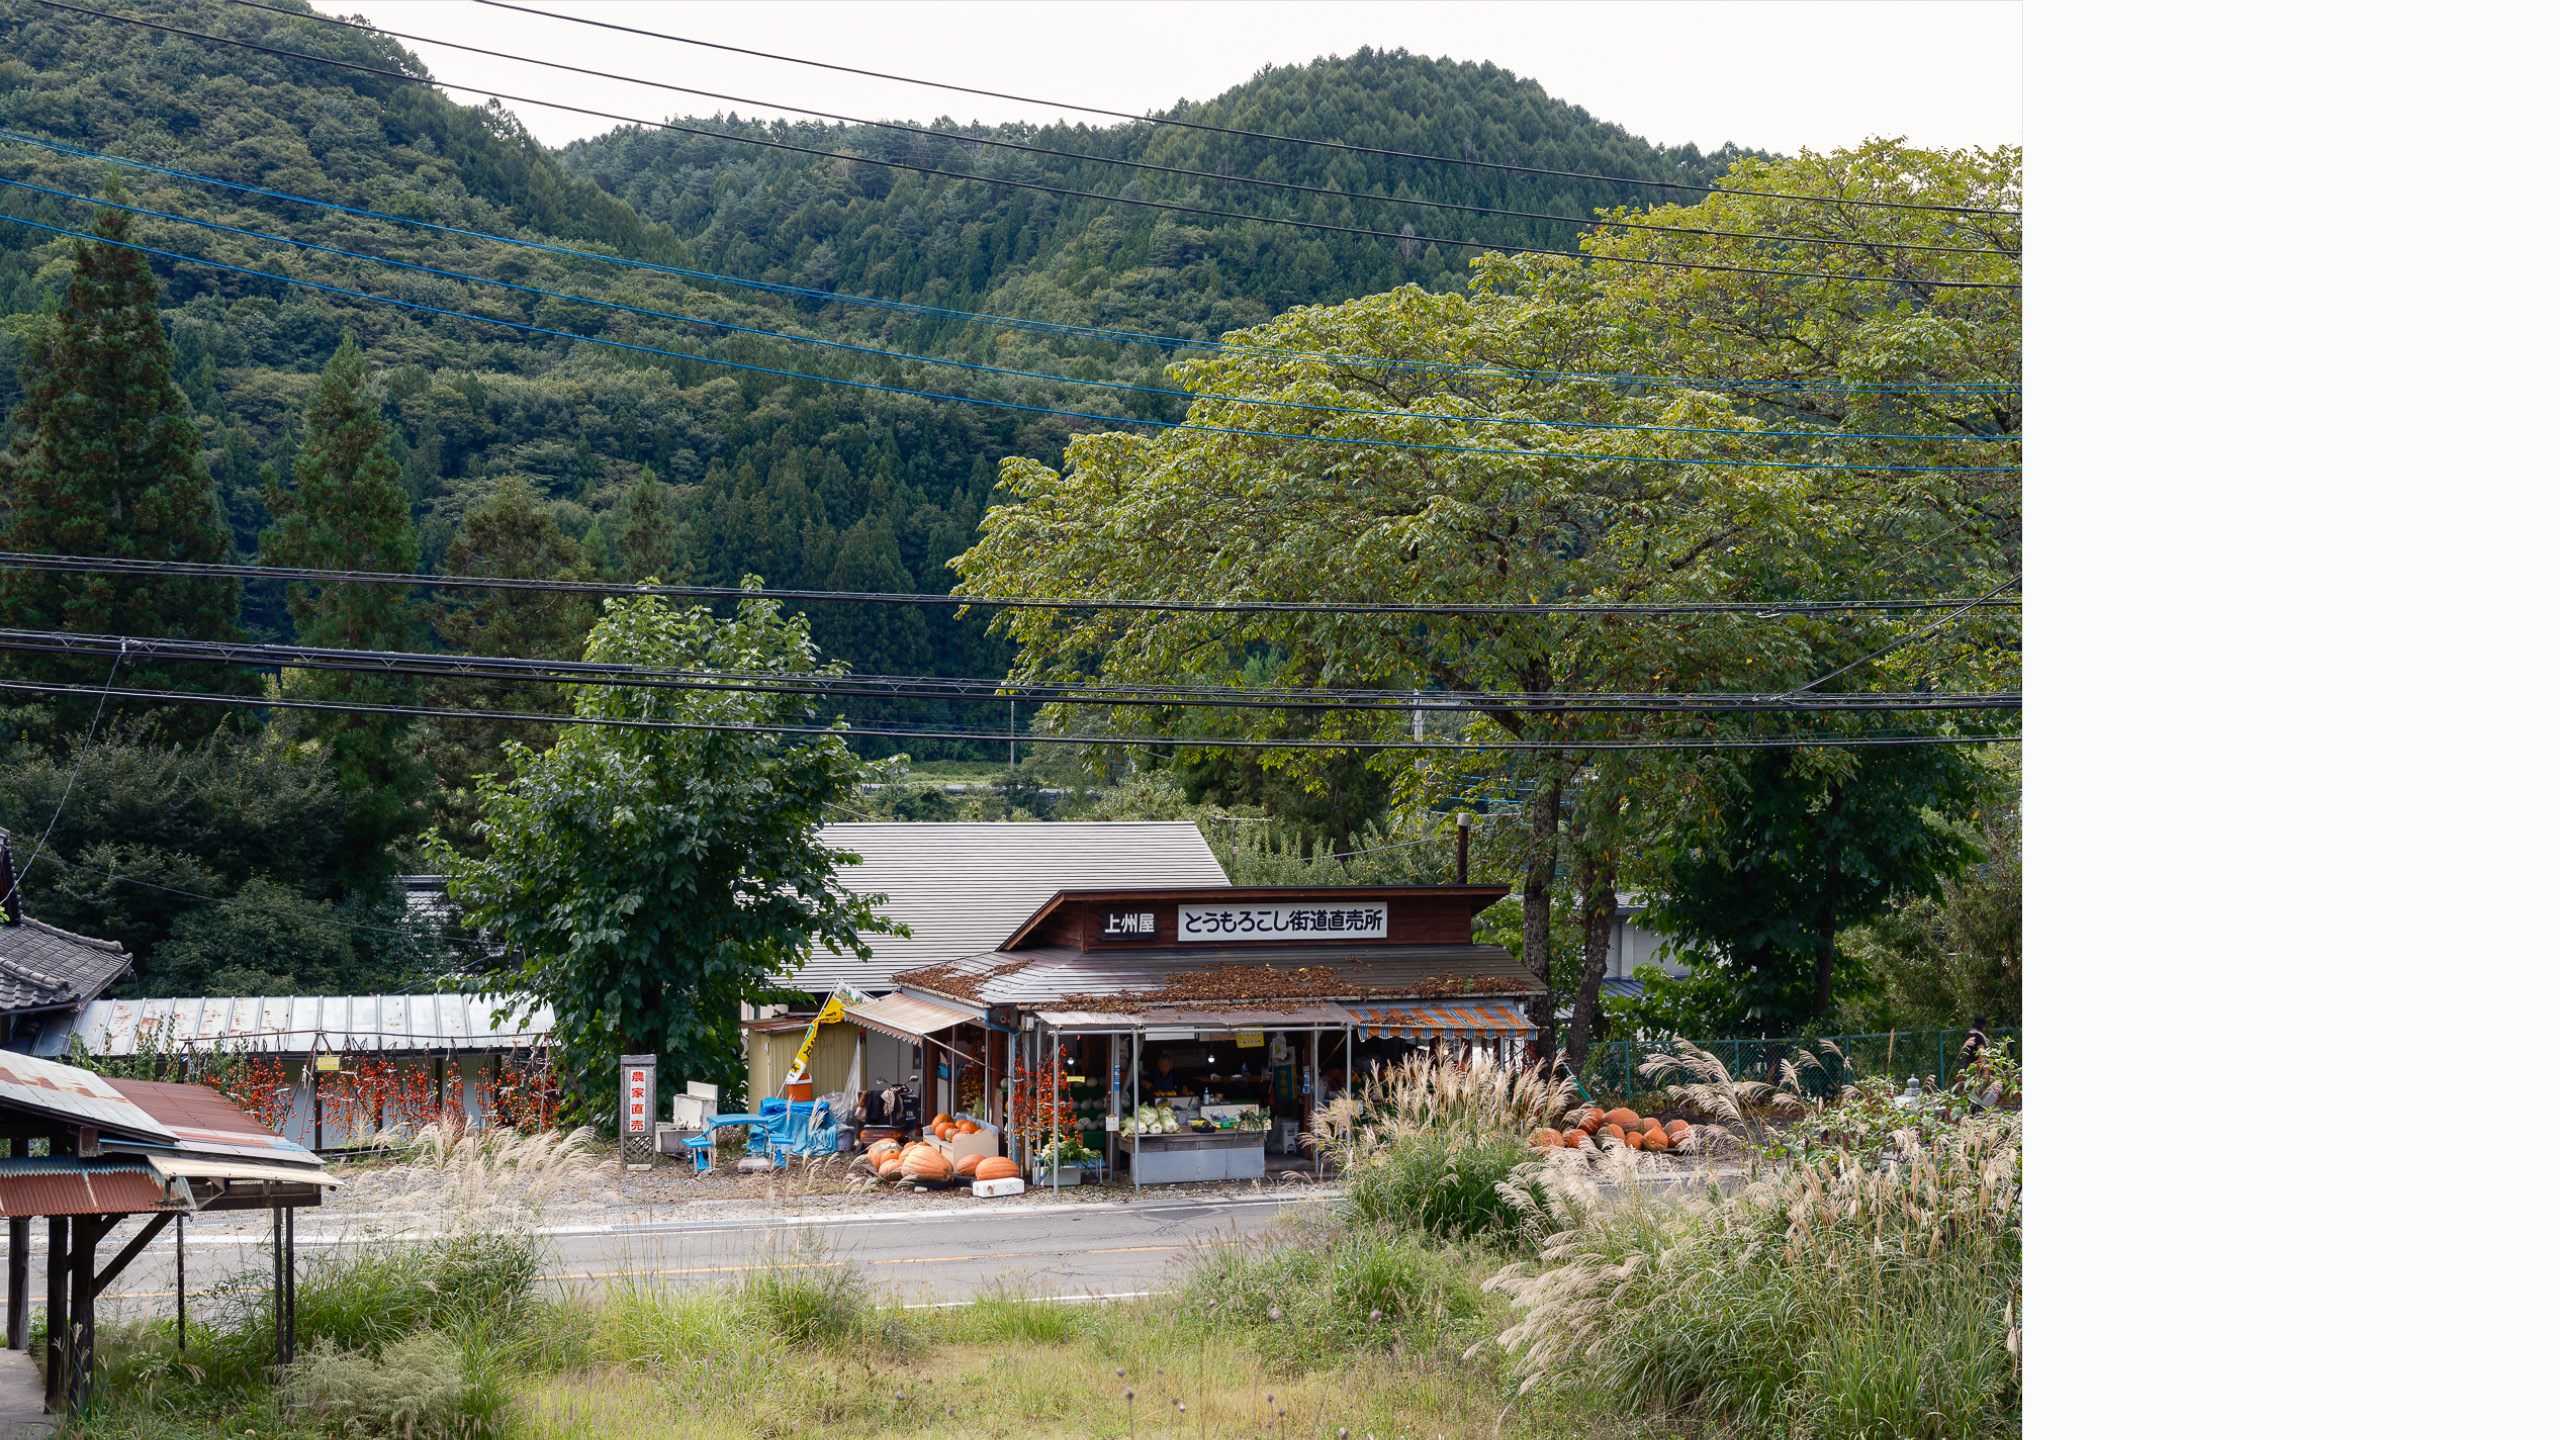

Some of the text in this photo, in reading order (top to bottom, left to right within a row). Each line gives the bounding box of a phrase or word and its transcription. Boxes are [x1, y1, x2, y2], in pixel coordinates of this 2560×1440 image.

[1104, 913, 1155, 933] 上州屋
[1185, 909, 1383, 933] とうもろこし街道直売所
[630, 1071, 645, 1131] 農家直売
